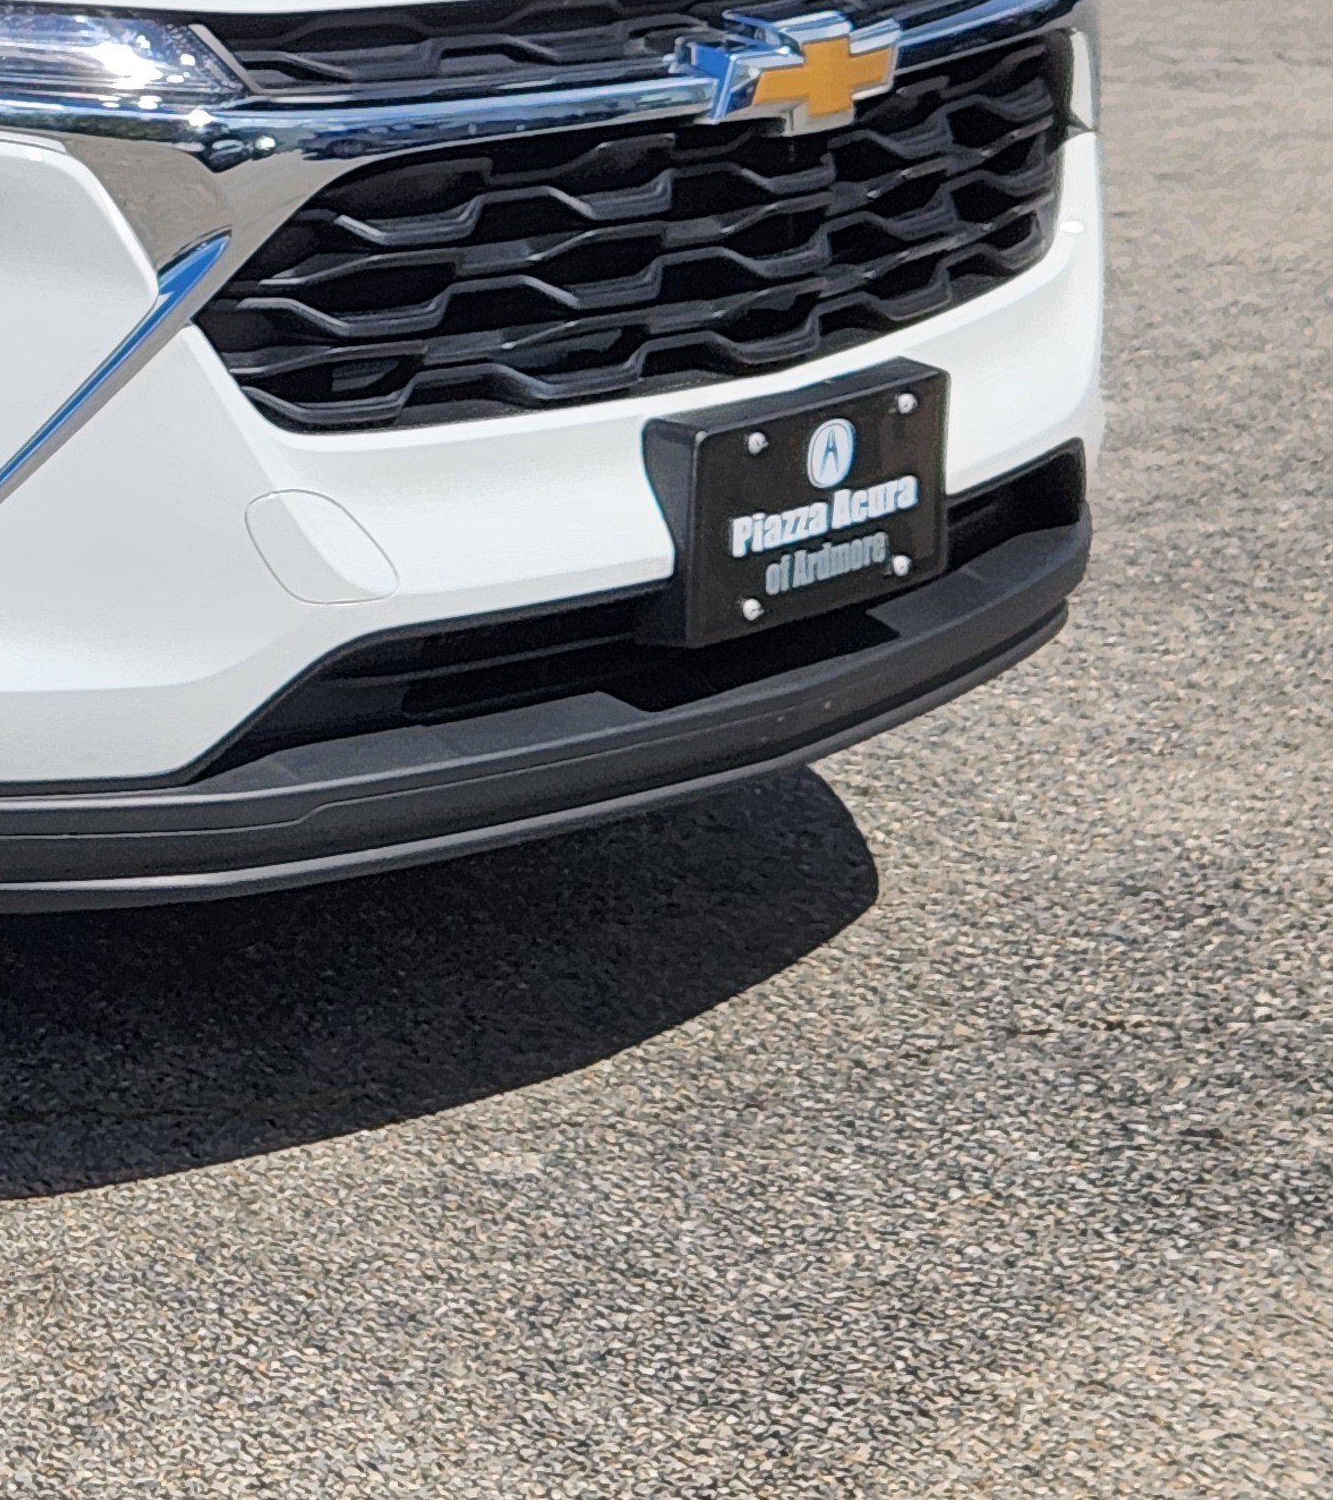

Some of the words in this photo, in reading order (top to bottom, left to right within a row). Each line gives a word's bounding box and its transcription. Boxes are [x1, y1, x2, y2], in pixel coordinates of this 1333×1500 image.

[731, 502, 829, 558] Piazza
[831, 475, 919, 530] Acura
[765, 554, 792, 595] of
